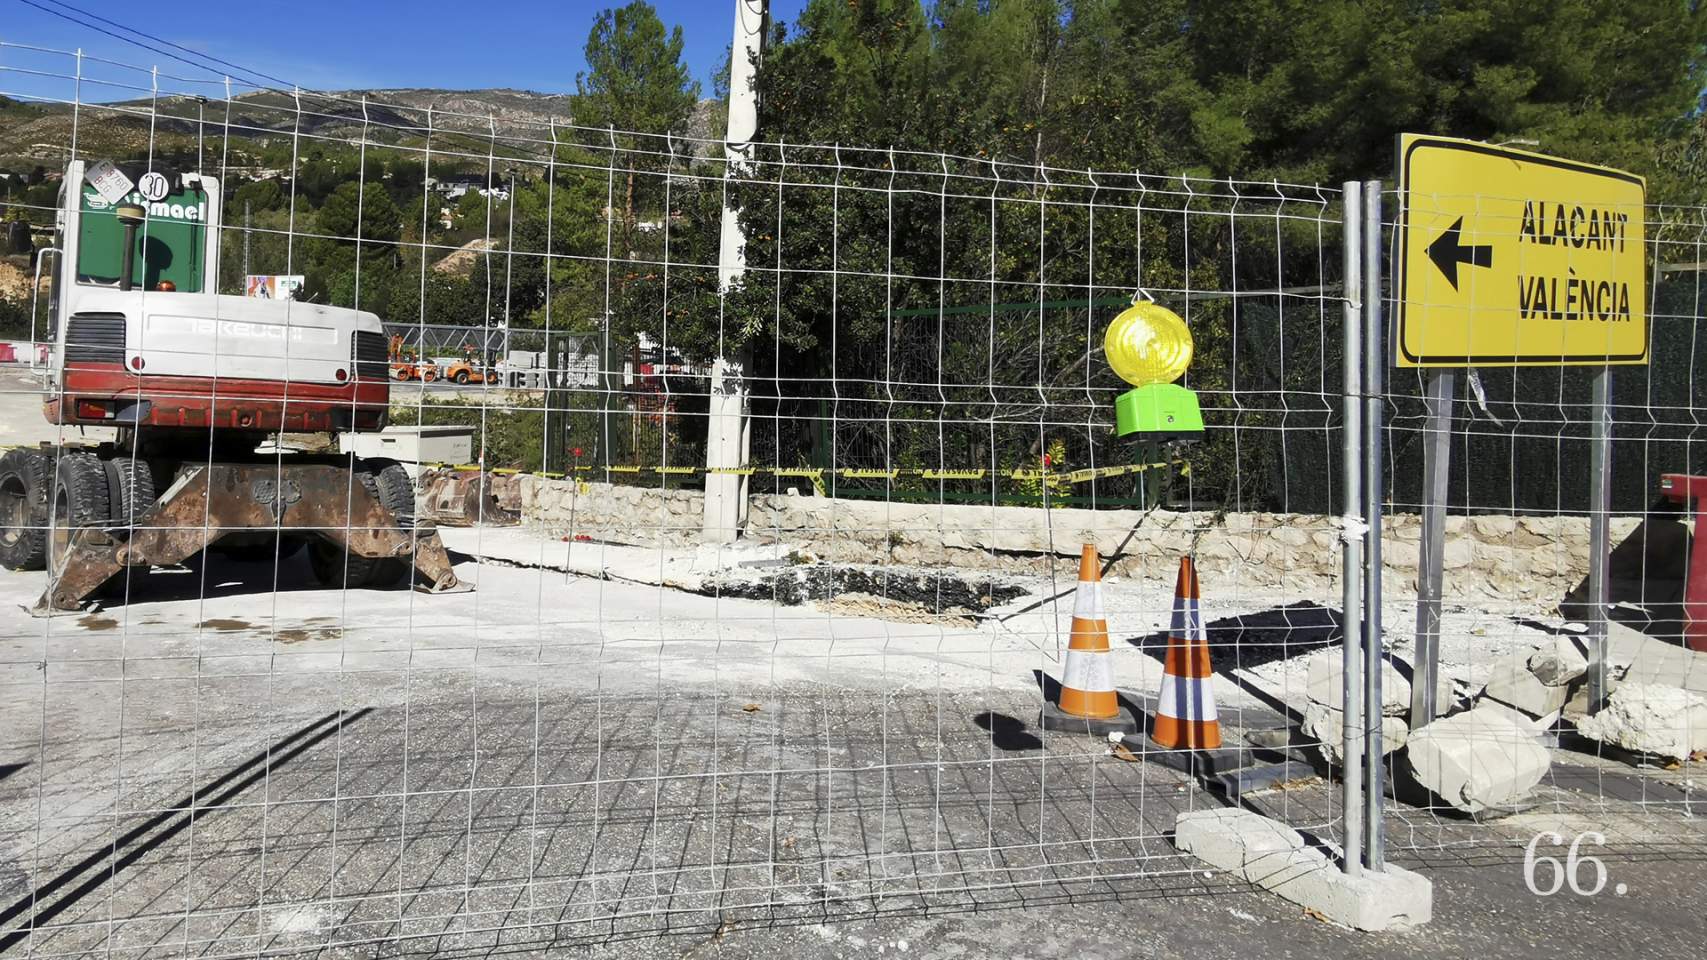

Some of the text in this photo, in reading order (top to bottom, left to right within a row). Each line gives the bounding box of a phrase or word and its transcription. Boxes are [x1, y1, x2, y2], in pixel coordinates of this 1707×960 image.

[143, 174, 164, 197] 30
[1518, 200, 1629, 253] ALACANT
[1517, 266, 1631, 322] VALÈNCIA
